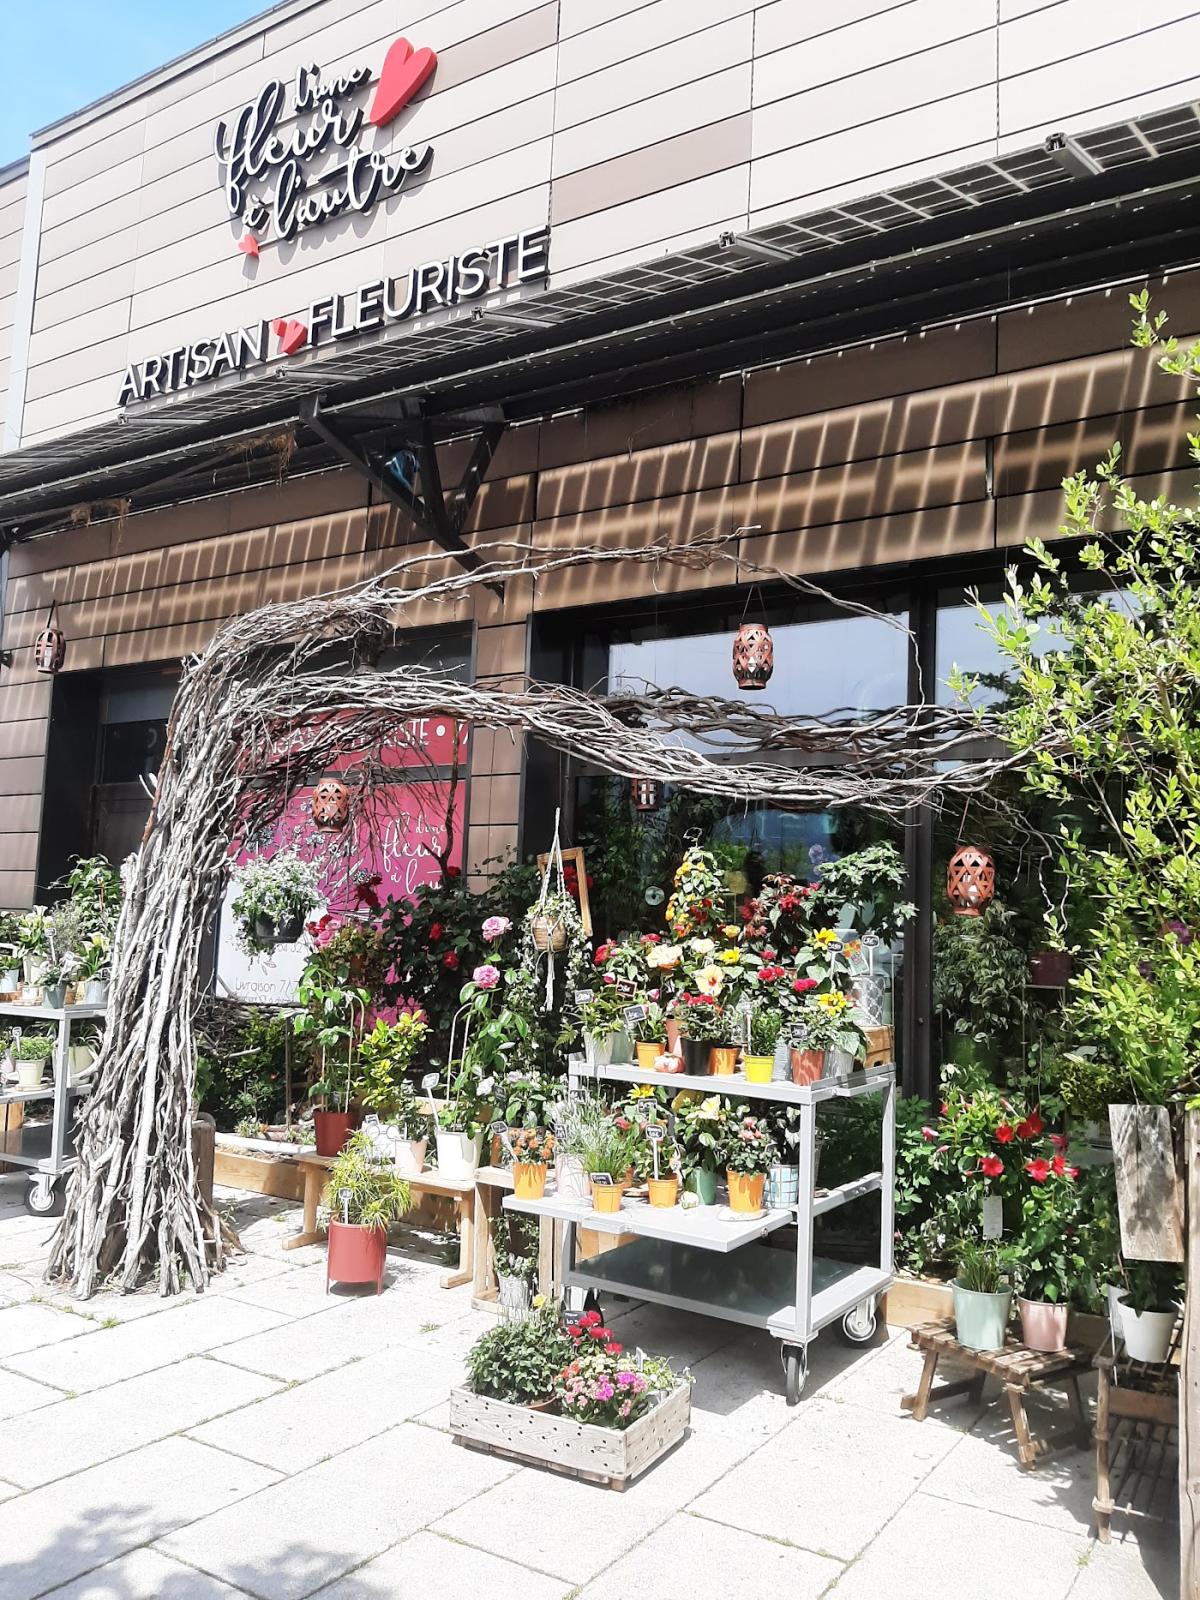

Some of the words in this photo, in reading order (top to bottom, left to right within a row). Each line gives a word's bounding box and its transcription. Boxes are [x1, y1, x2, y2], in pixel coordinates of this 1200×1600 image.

[291, 63, 372, 112] d'une
[213, 78, 364, 216] fleur
[241, 194, 270, 230] à
[273, 145, 434, 241] l'autre
[116, 319, 268, 406] ARTISAN
[306, 224, 550, 345] FLEURISTE
[381, 819, 442, 873] fleur
